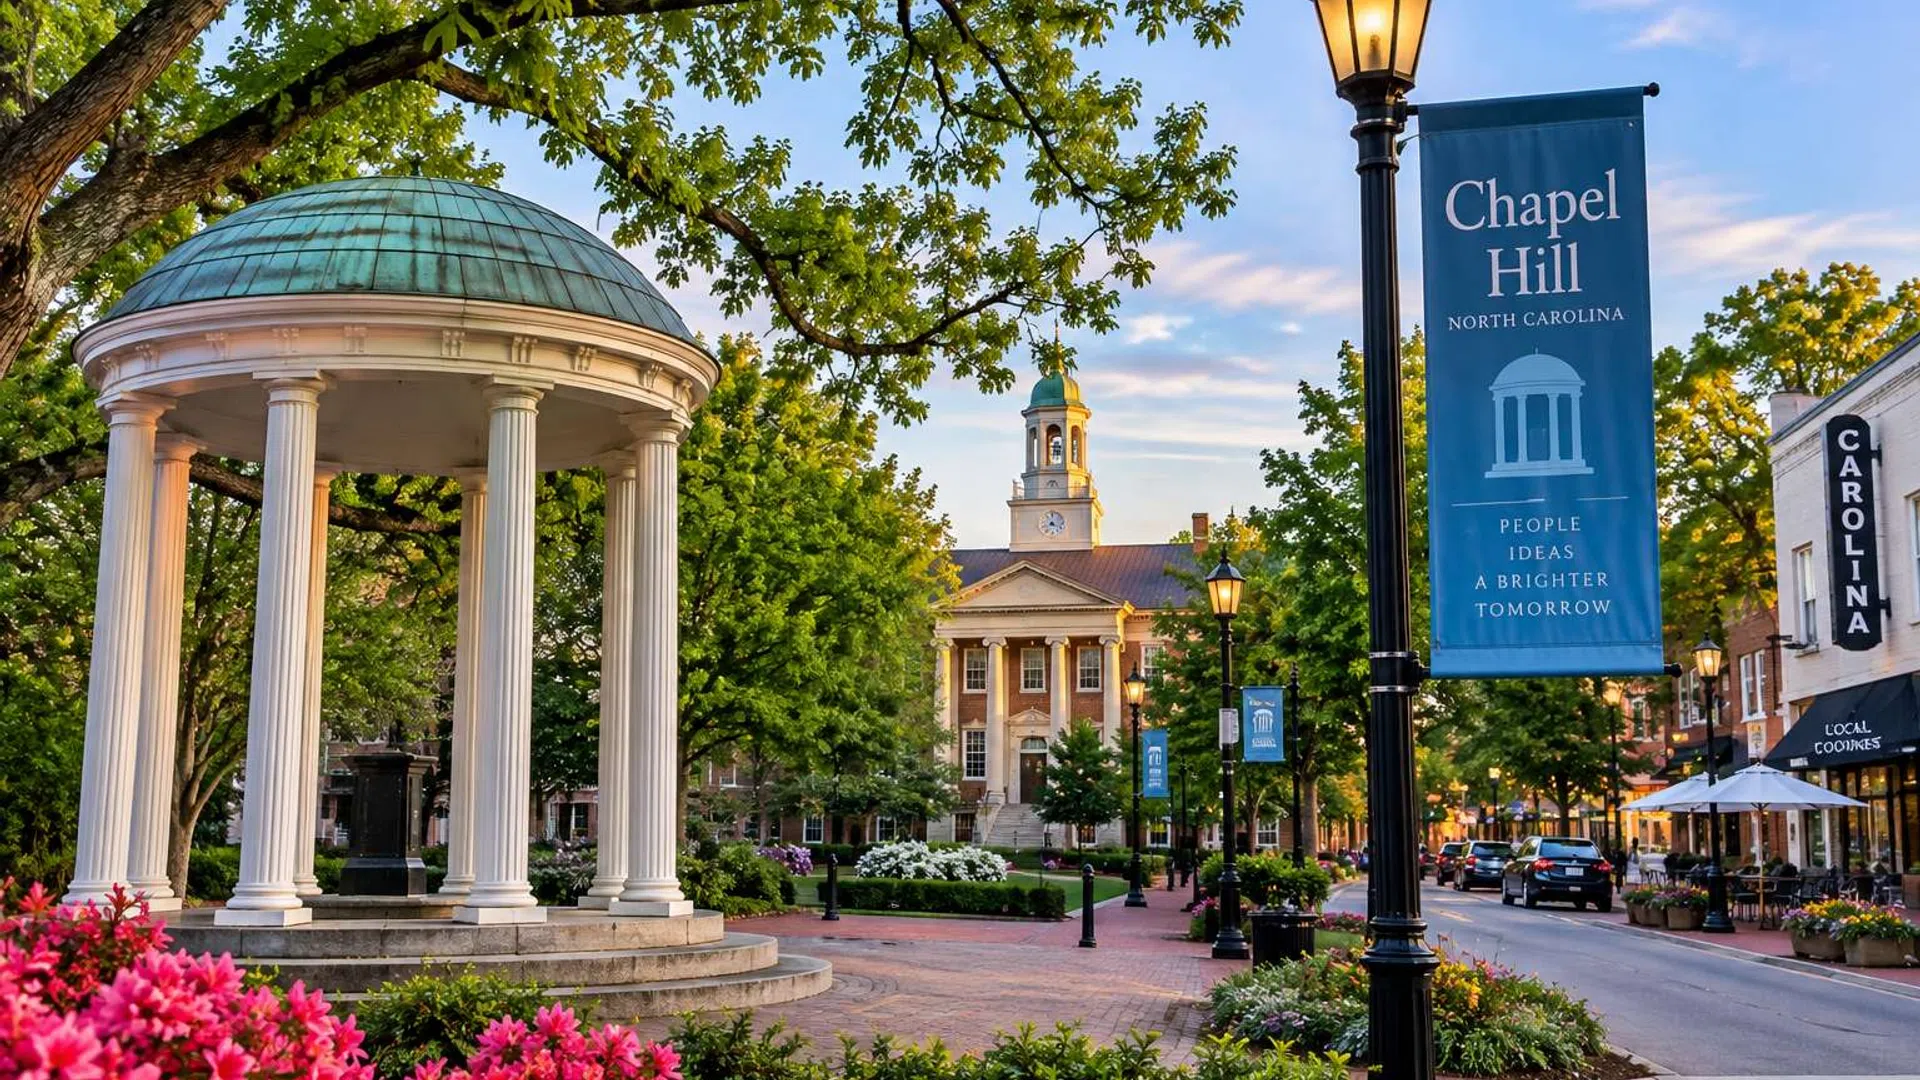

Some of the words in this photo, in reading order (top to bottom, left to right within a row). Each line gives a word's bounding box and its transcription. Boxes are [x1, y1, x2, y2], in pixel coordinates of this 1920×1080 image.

[1445, 168, 1621, 239] Chapel
[1487, 242, 1583, 298] Hill
[1448, 312, 1516, 331] NORTH
[1523, 307, 1625, 327] CAROLINA
[1500, 516, 1581, 534] PEOPLE
[1838, 429, 1870, 634] CAROLINA
[1510, 545, 1574, 561] IDEAS
[1475, 575, 1488, 590] A
[1498, 572, 1609, 589] BRIGHTER
[1474, 600, 1612, 618] TOMORROW
[1825, 720, 1872, 737] LOCAL
